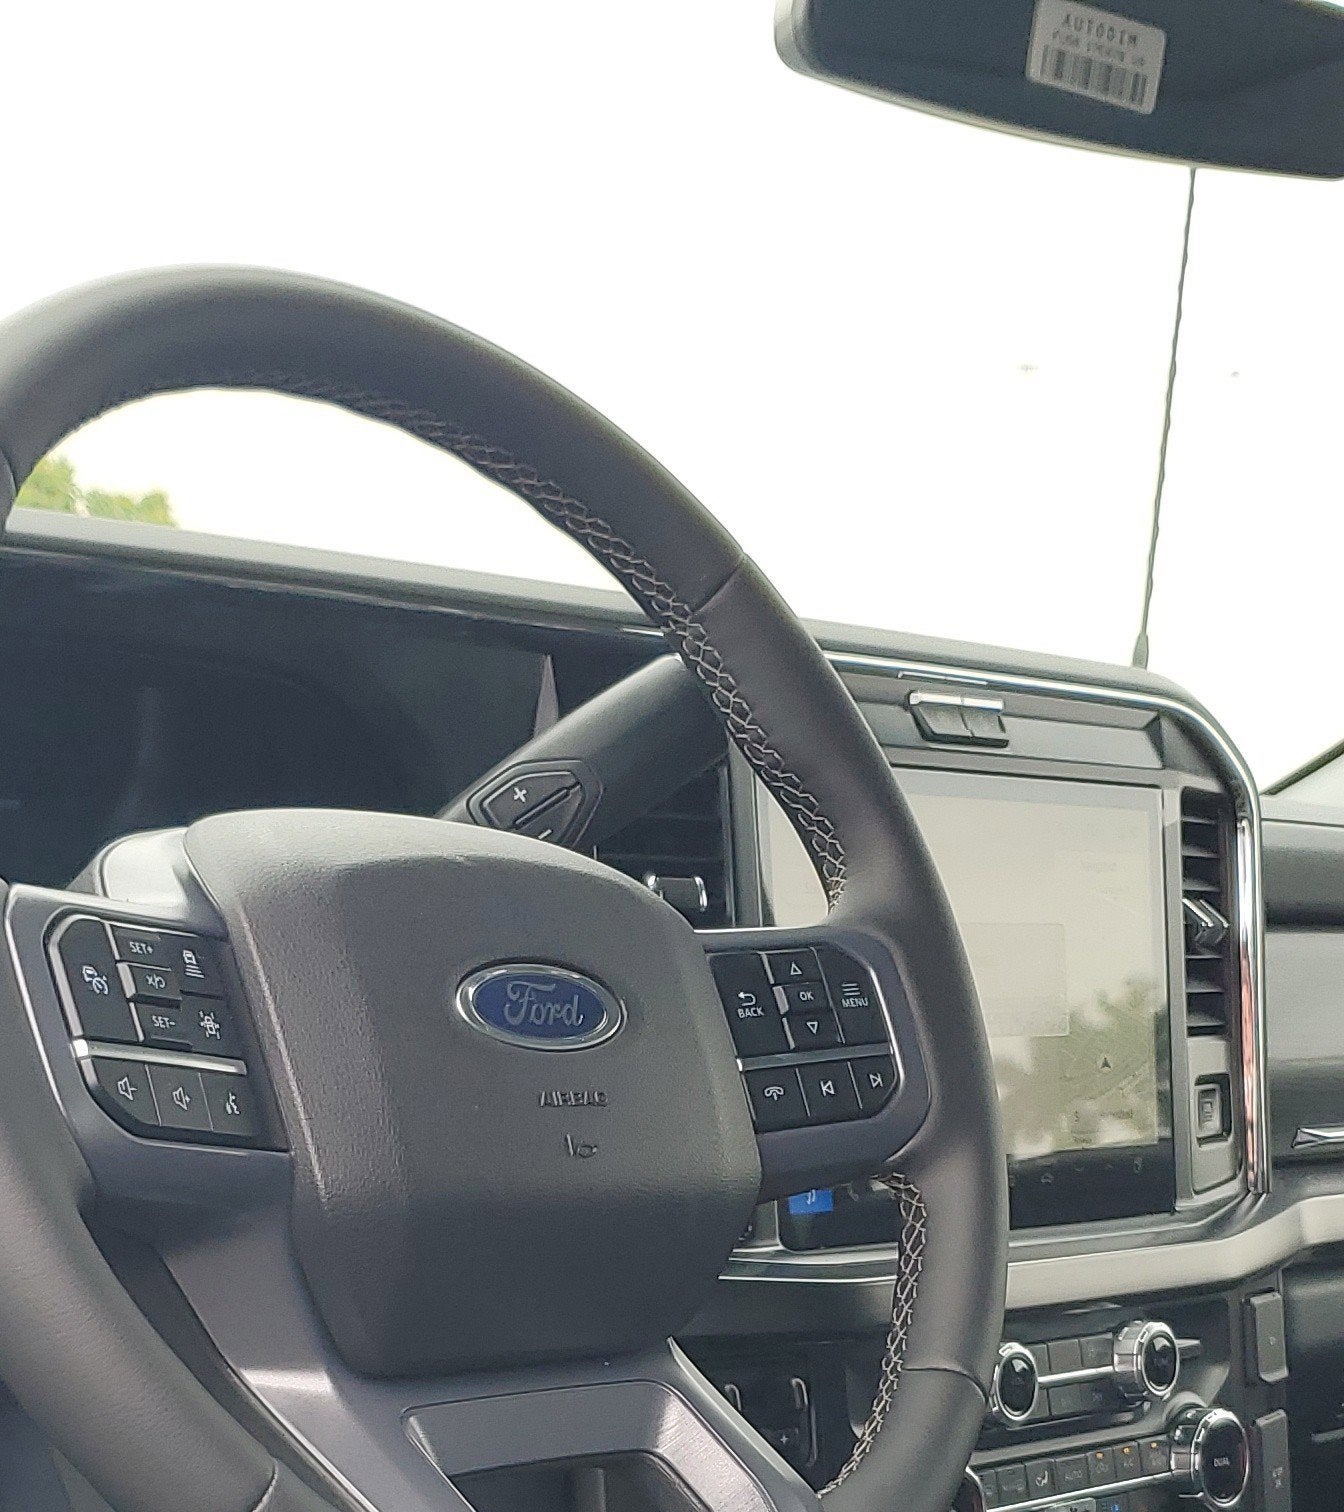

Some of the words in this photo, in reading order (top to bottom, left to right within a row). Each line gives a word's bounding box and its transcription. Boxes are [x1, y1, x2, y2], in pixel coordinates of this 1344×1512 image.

[129, 941, 154, 956] SET+
[799, 990, 815, 1001] OK
[504, 980, 584, 1027] Ford
[841, 997, 869, 1008] MENU
[737, 1006, 765, 1019] BACK
